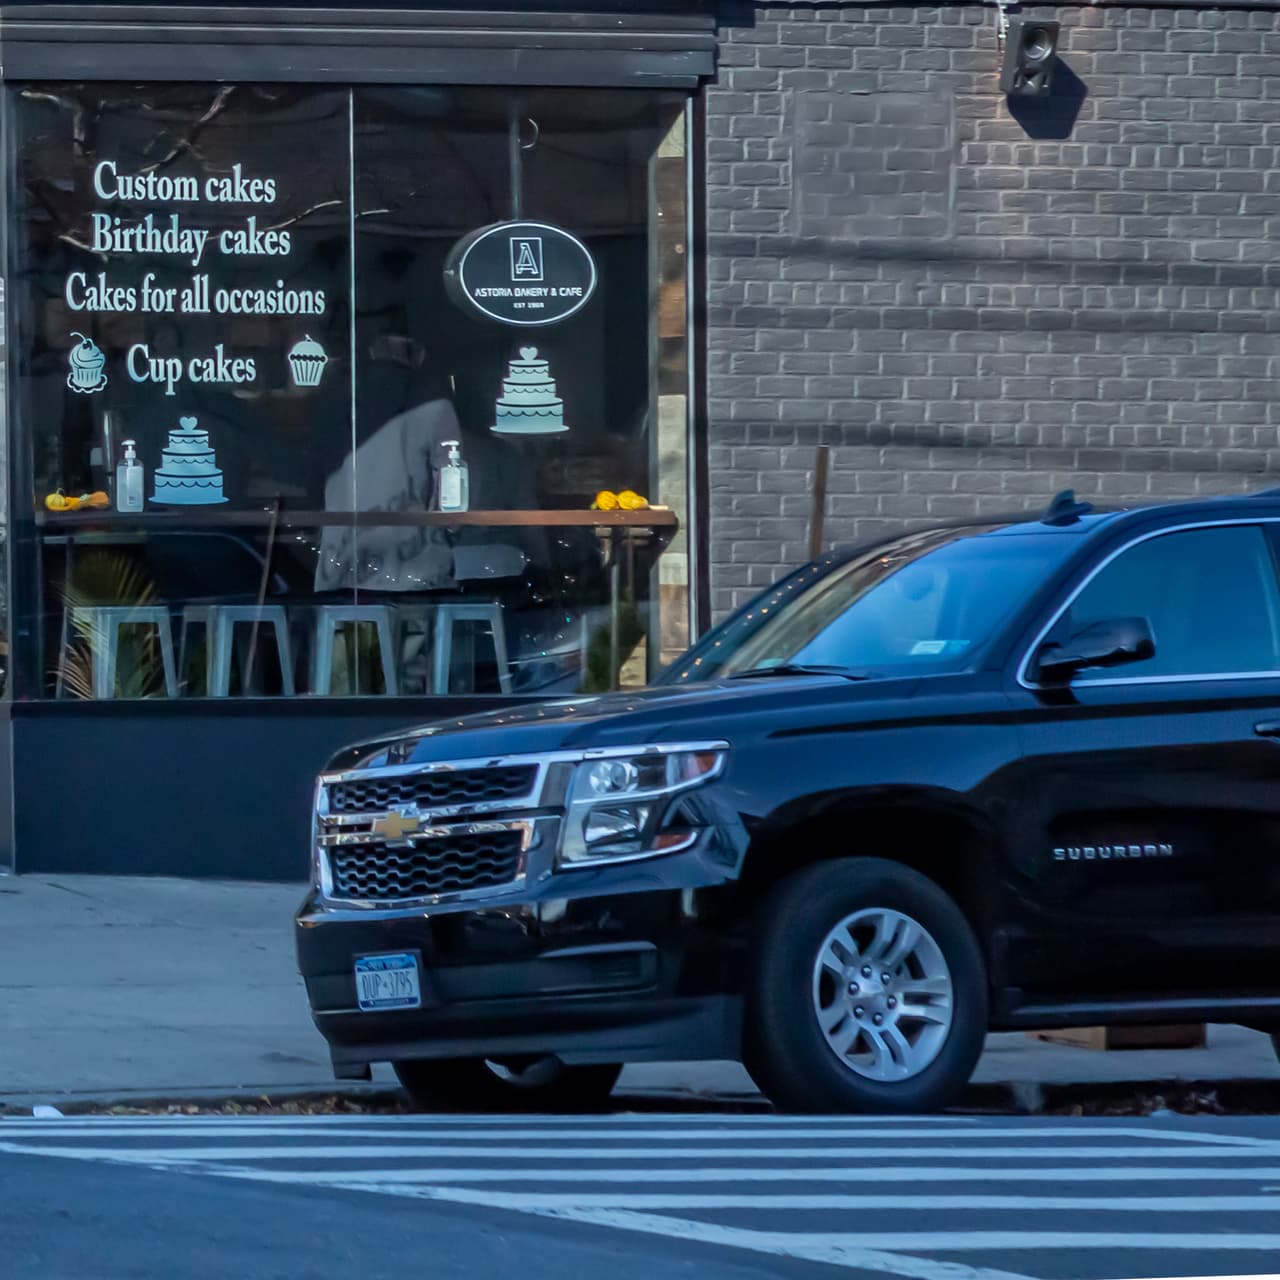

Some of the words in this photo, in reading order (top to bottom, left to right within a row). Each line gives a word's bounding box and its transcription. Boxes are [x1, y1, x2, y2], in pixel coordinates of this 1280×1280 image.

[93, 160, 199, 203] Custom
[205, 162, 276, 203] cakes
[91, 213, 209, 267] Birthday
[220, 218, 290, 256] cakes
[64, 272, 136, 314] Cakes
[142, 275, 179, 313] for
[180, 275, 209, 313] all
[214, 280, 326, 316] occasions
[475, 288, 513, 297] ASTORIA
[514, 288, 549, 297] BAKERY
[559, 287, 582, 296] CAFE
[126, 344, 183, 396] Cup
[188, 344, 256, 383] cakes
[1053, 844, 1173, 860] SUBURBAN
